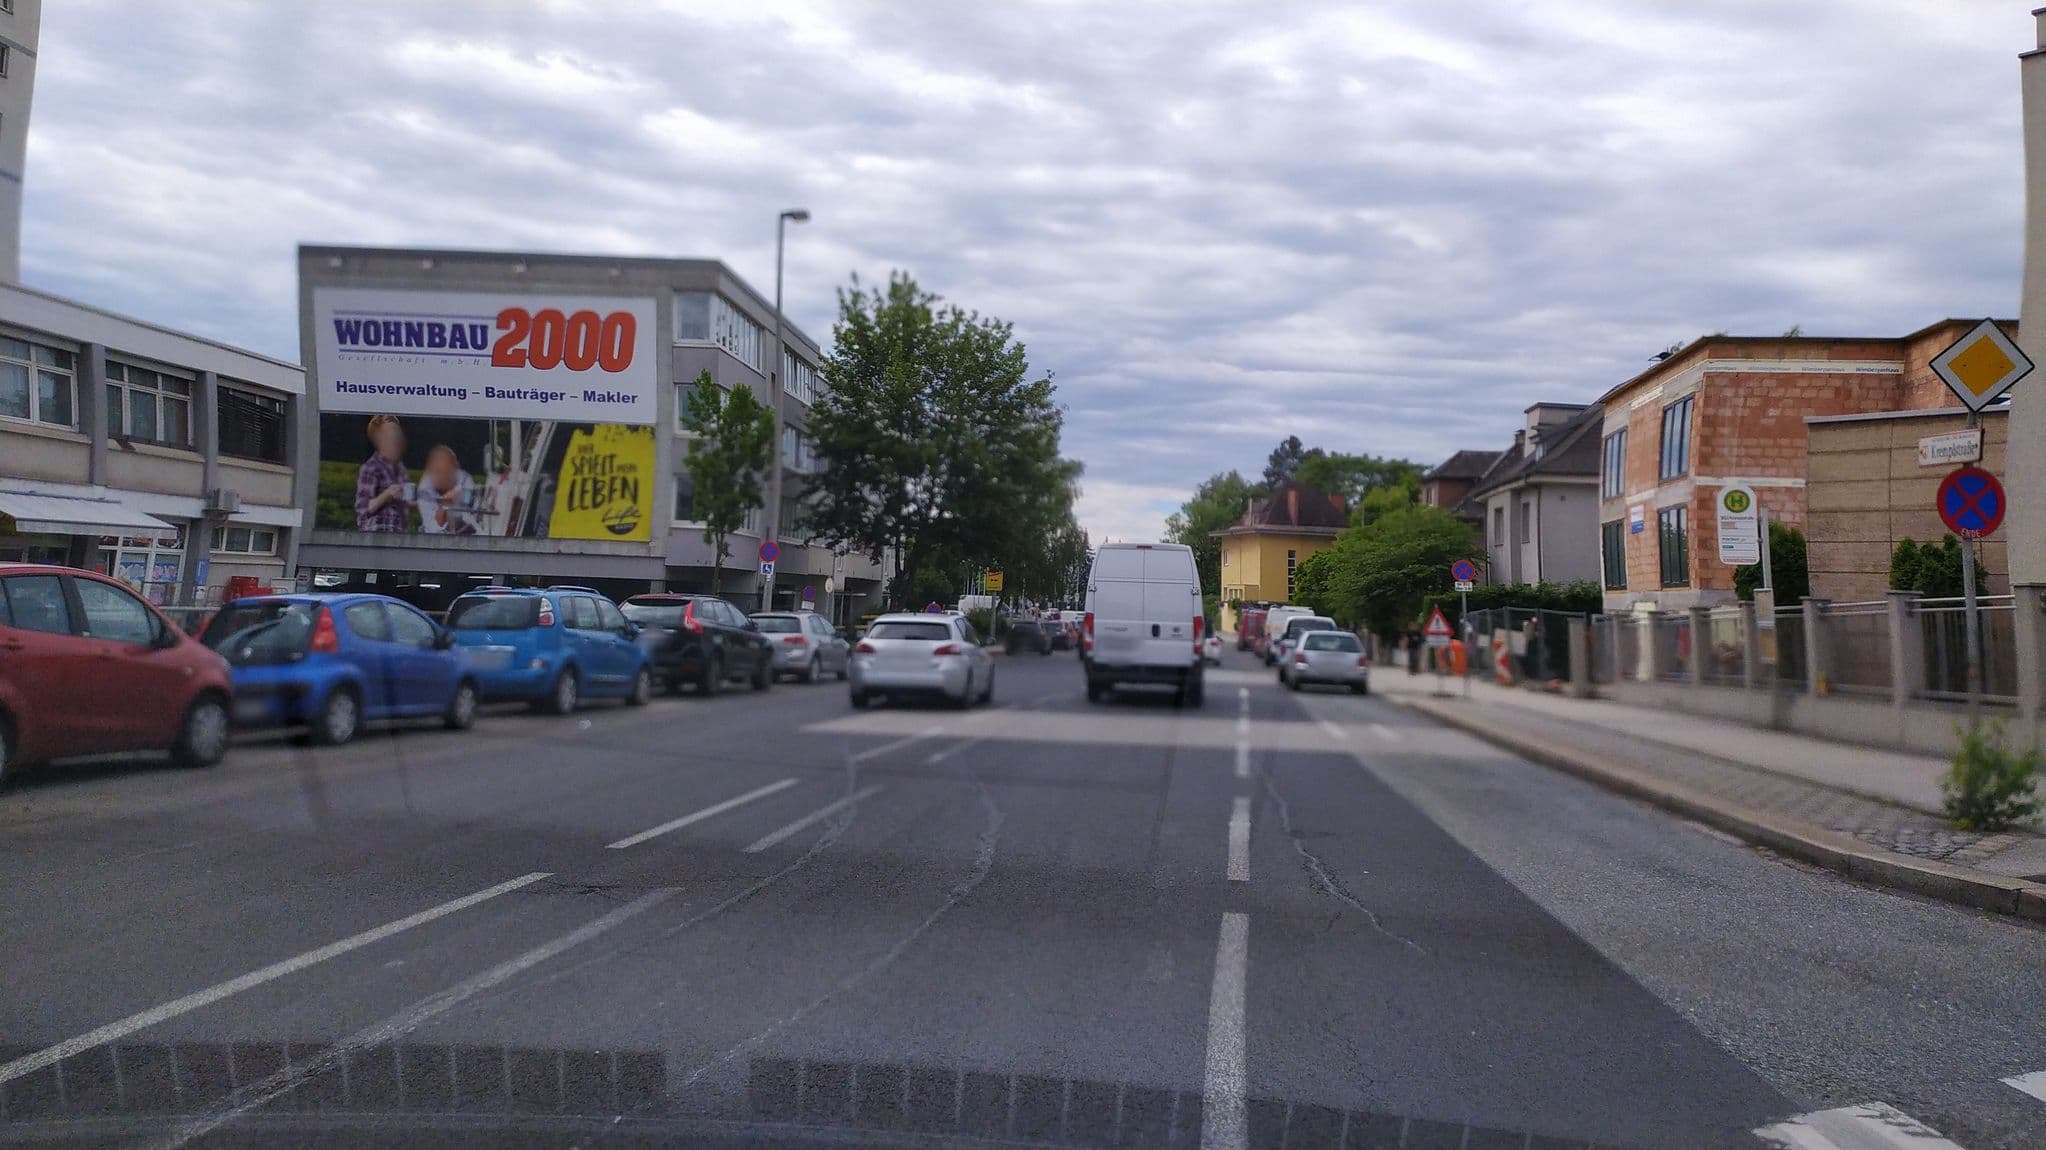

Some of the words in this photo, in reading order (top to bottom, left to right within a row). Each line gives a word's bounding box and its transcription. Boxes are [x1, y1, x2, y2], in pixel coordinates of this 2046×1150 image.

[334, 319, 489, 350] WOHNBAU
[491, 307, 637, 373] 2000
[338, 354, 426, 365] Gesellschaft
[336, 381, 467, 400] Hausverwaltung
[485, 386, 566, 404] Bauträger
[583, 390, 638, 404] Makler
[567, 475, 638, 513] LEBEN
